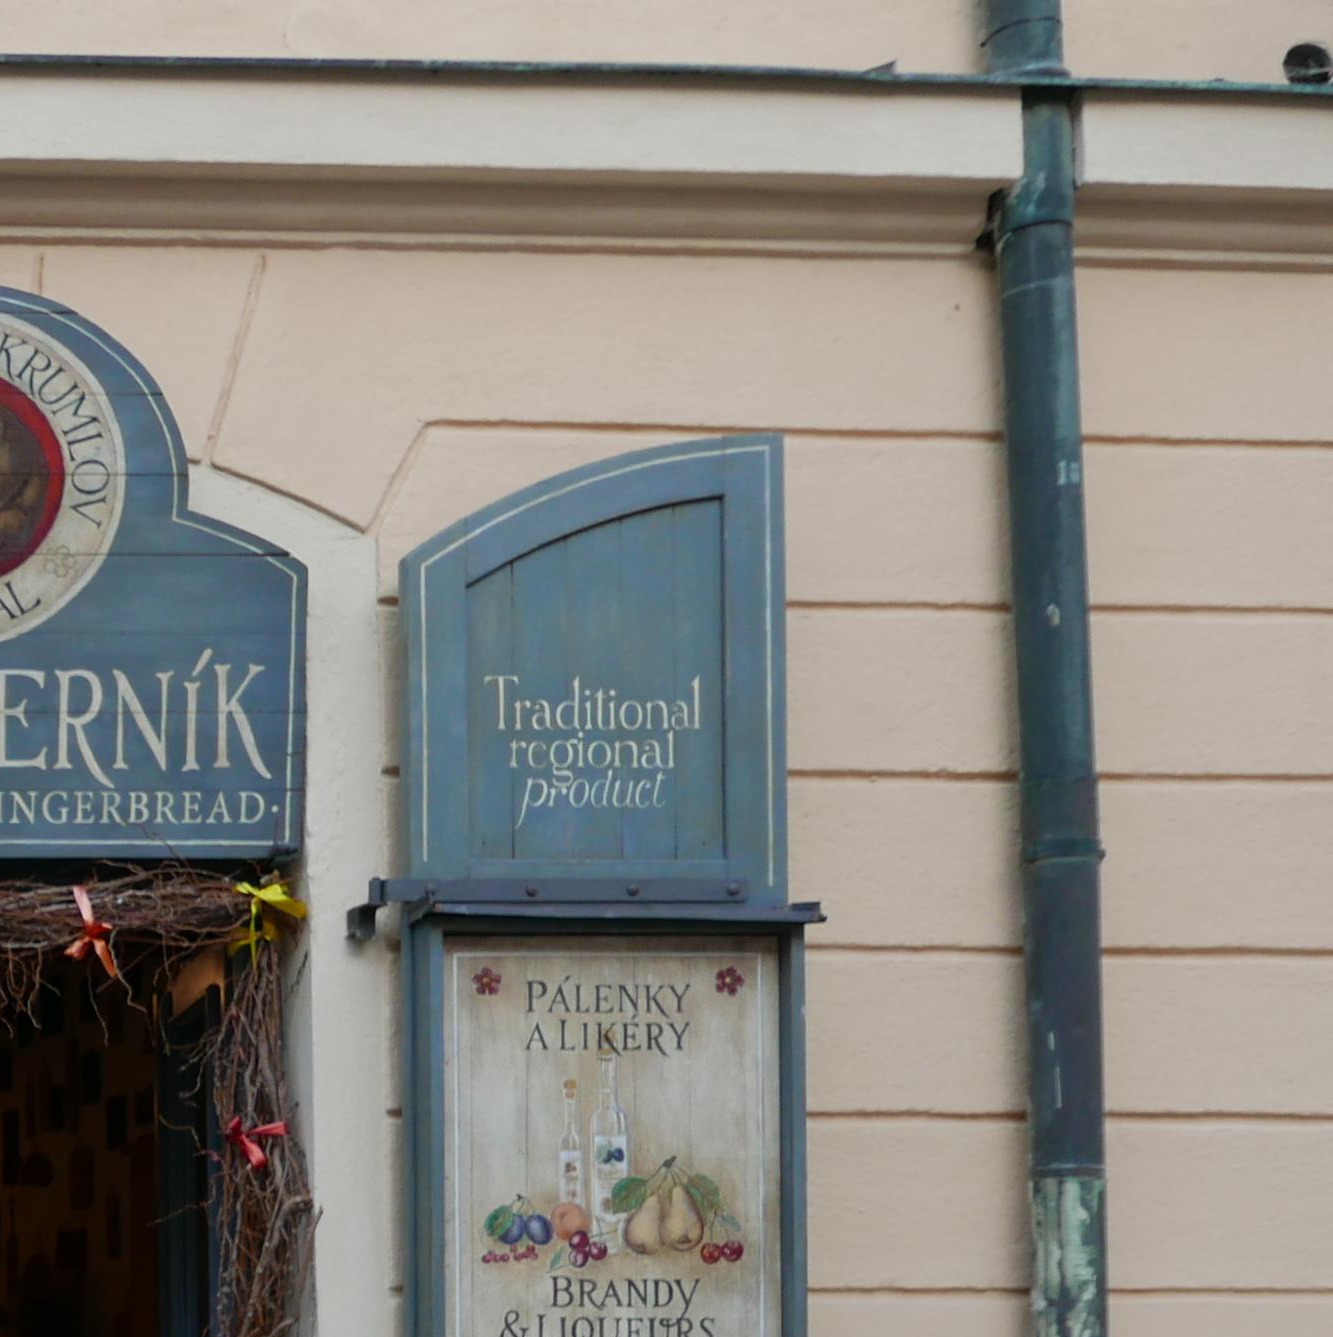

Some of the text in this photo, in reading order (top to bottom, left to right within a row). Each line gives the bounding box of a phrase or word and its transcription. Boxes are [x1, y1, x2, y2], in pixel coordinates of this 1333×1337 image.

[484, 675, 701, 730] Traditional
[509, 731, 675, 788] regional
[516, 769, 665, 827] product
[525, 976, 691, 1018] PÁLENKY
[550, 1276, 701, 1328] BRANDY
